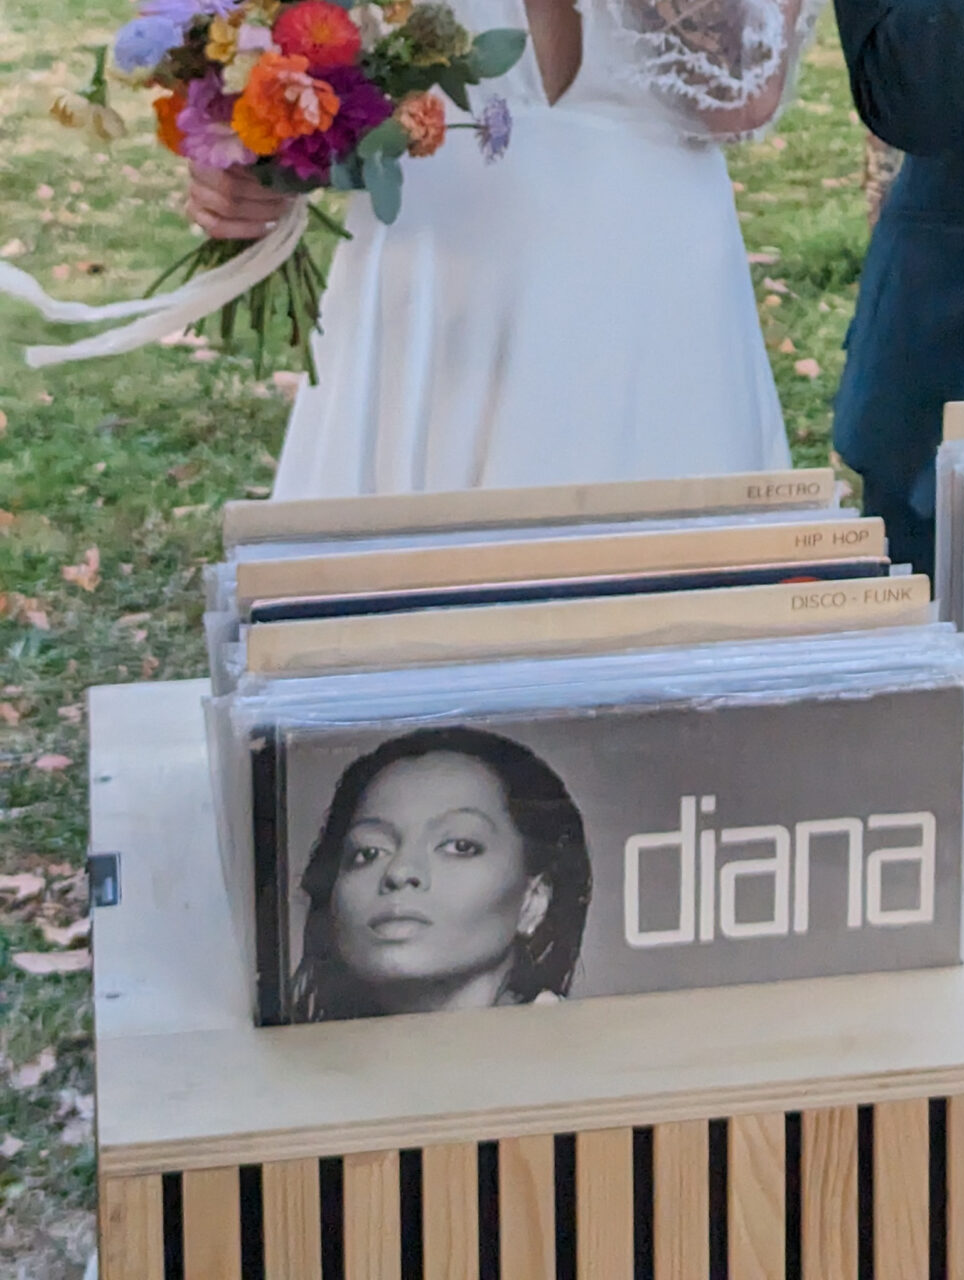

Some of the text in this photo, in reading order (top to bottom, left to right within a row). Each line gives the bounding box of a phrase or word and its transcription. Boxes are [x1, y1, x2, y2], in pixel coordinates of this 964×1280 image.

[746, 482, 821, 499] ELECTRO
[795, 530, 869, 548] HIP HOP
[791, 591, 847, 611] DISCO
[863, 587, 913, 604] FUNK
[623, 794, 937, 950] diana
